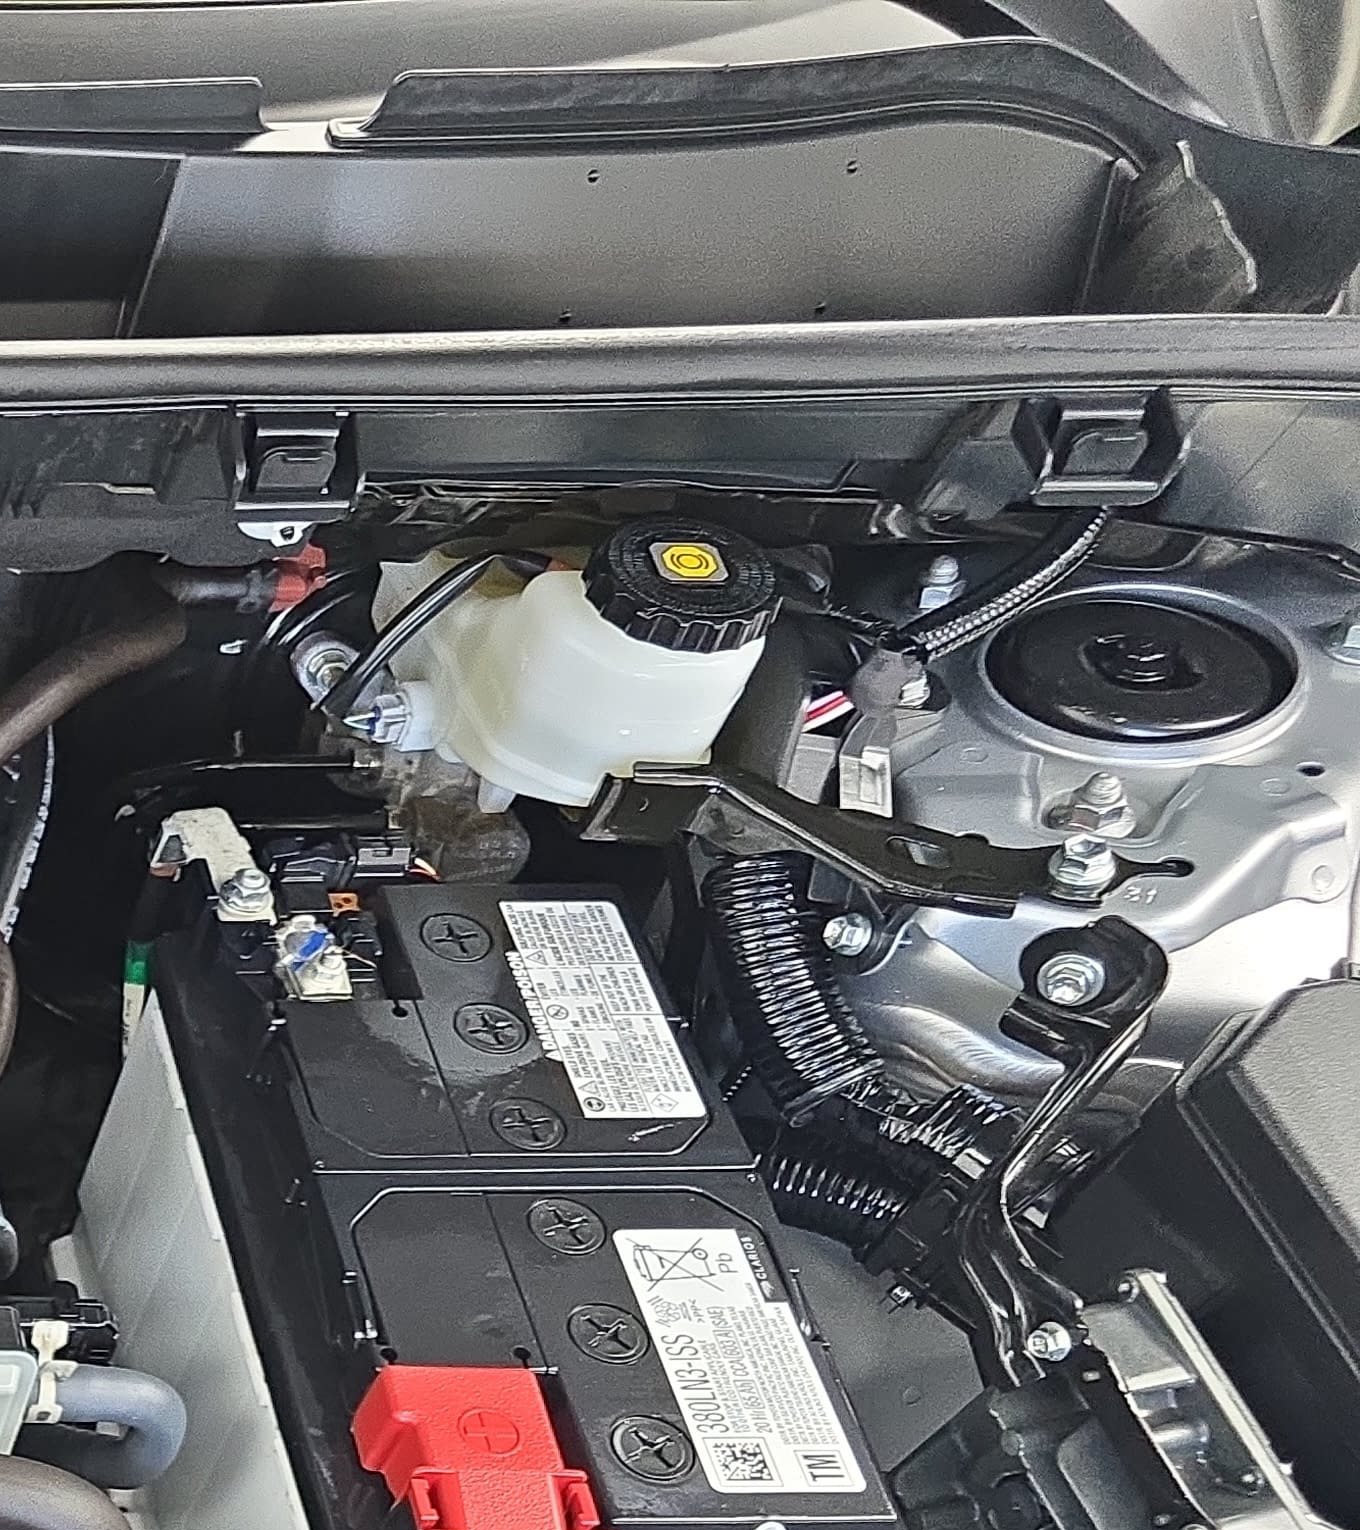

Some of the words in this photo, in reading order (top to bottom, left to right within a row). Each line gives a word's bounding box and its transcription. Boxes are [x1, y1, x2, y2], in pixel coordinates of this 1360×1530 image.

[505, 951, 556, 1049] DANGER/POISON
[712, 1252, 738, 1273] Pb
[705, 1305, 732, 1327] (SAE)
[727, 1359, 750, 1376] CCA
[658, 1334, 730, 1432] 380LN3-ISS
[801, 1454, 846, 1481] TM
